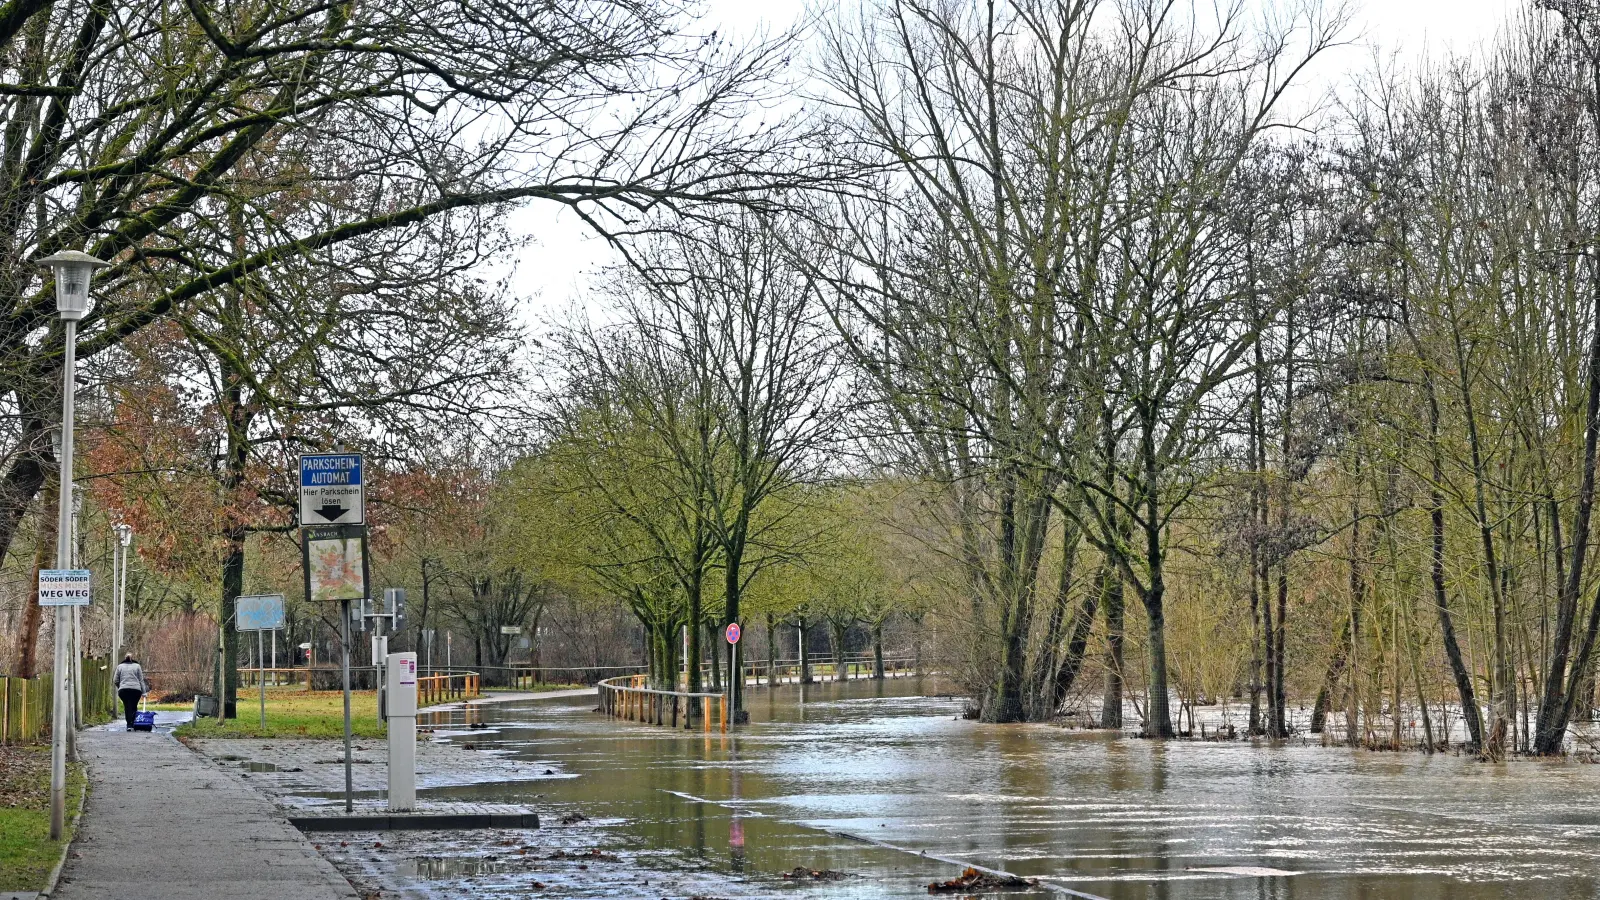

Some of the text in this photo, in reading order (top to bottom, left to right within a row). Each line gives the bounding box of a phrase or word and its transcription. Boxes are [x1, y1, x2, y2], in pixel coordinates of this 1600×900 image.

[302, 458, 359, 470] PARKSCHEIN-
[311, 472, 350, 484] AUTOMAT
[303, 487, 360, 496] Hier Parkschein
[321, 497, 341, 505] lösen
